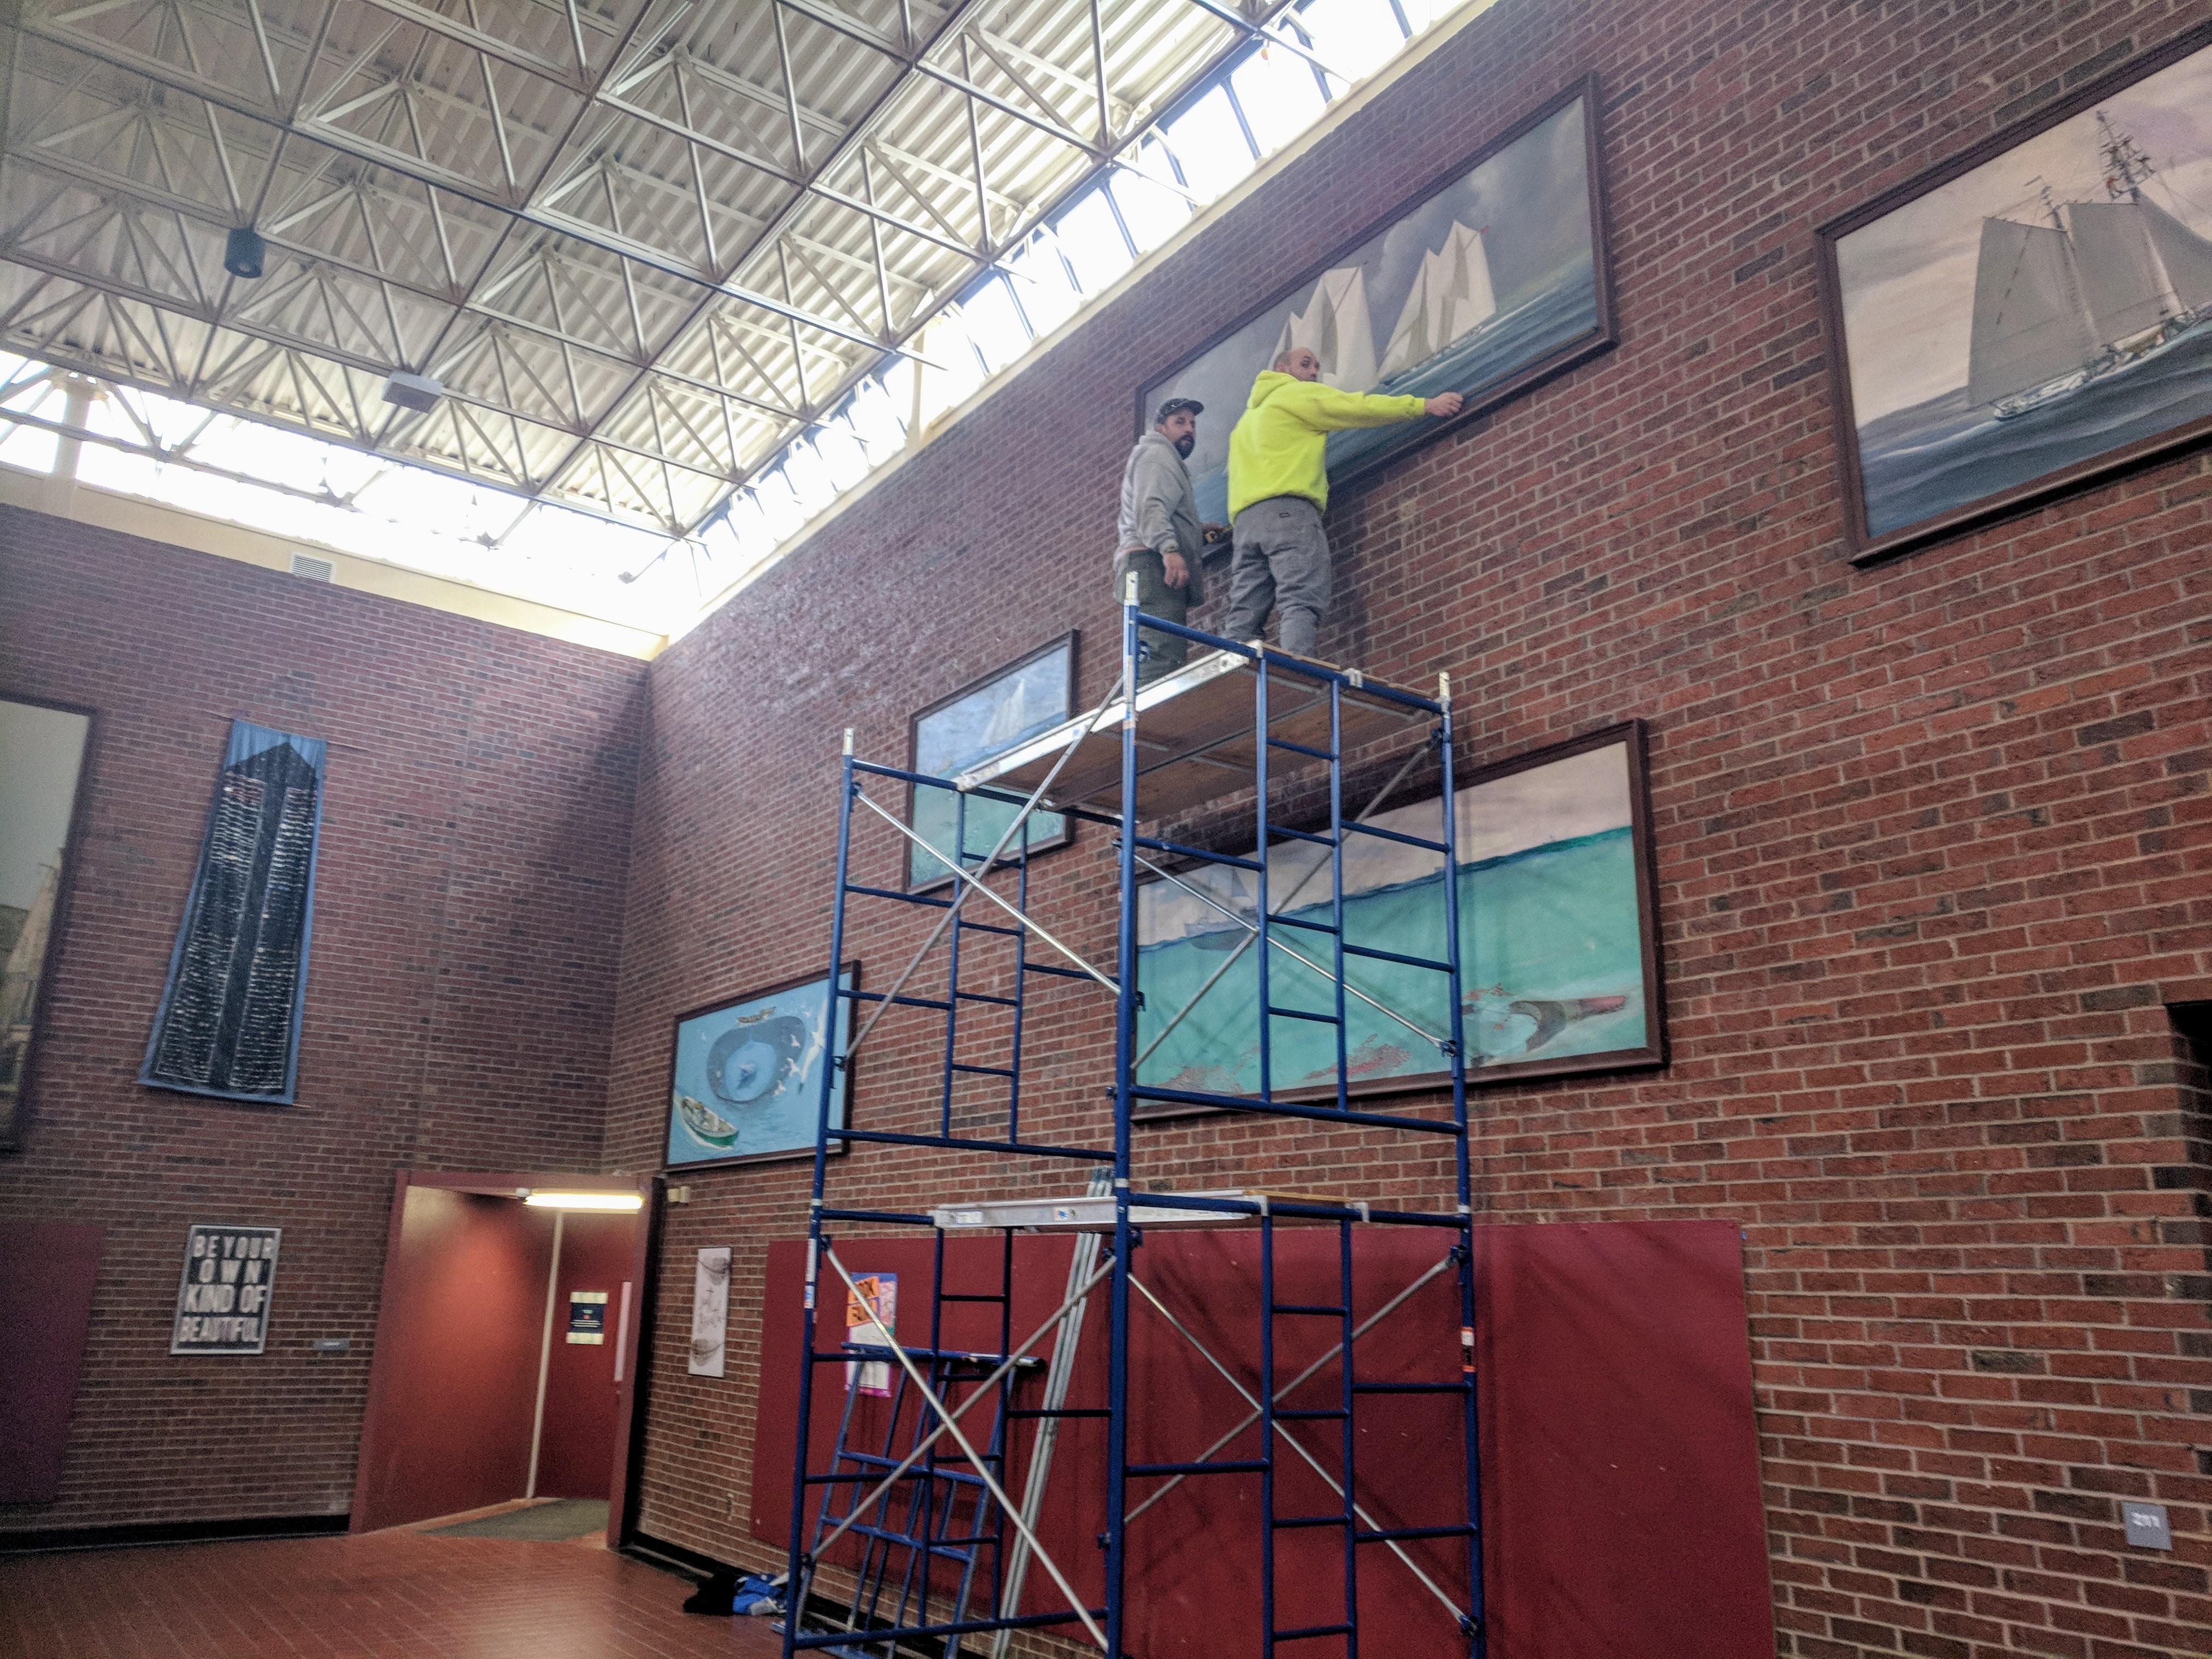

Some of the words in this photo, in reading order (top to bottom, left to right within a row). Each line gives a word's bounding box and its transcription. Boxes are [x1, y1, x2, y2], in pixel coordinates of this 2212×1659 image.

[193, 1235, 220, 1257] BE
[223, 1236, 274, 1259] YOUR
[199, 1258, 262, 1283] OWN
[184, 1284, 234, 1313] KIND
[239, 1285, 267, 1313] OF
[178, 1316, 260, 1342] BEAUTIFUL
